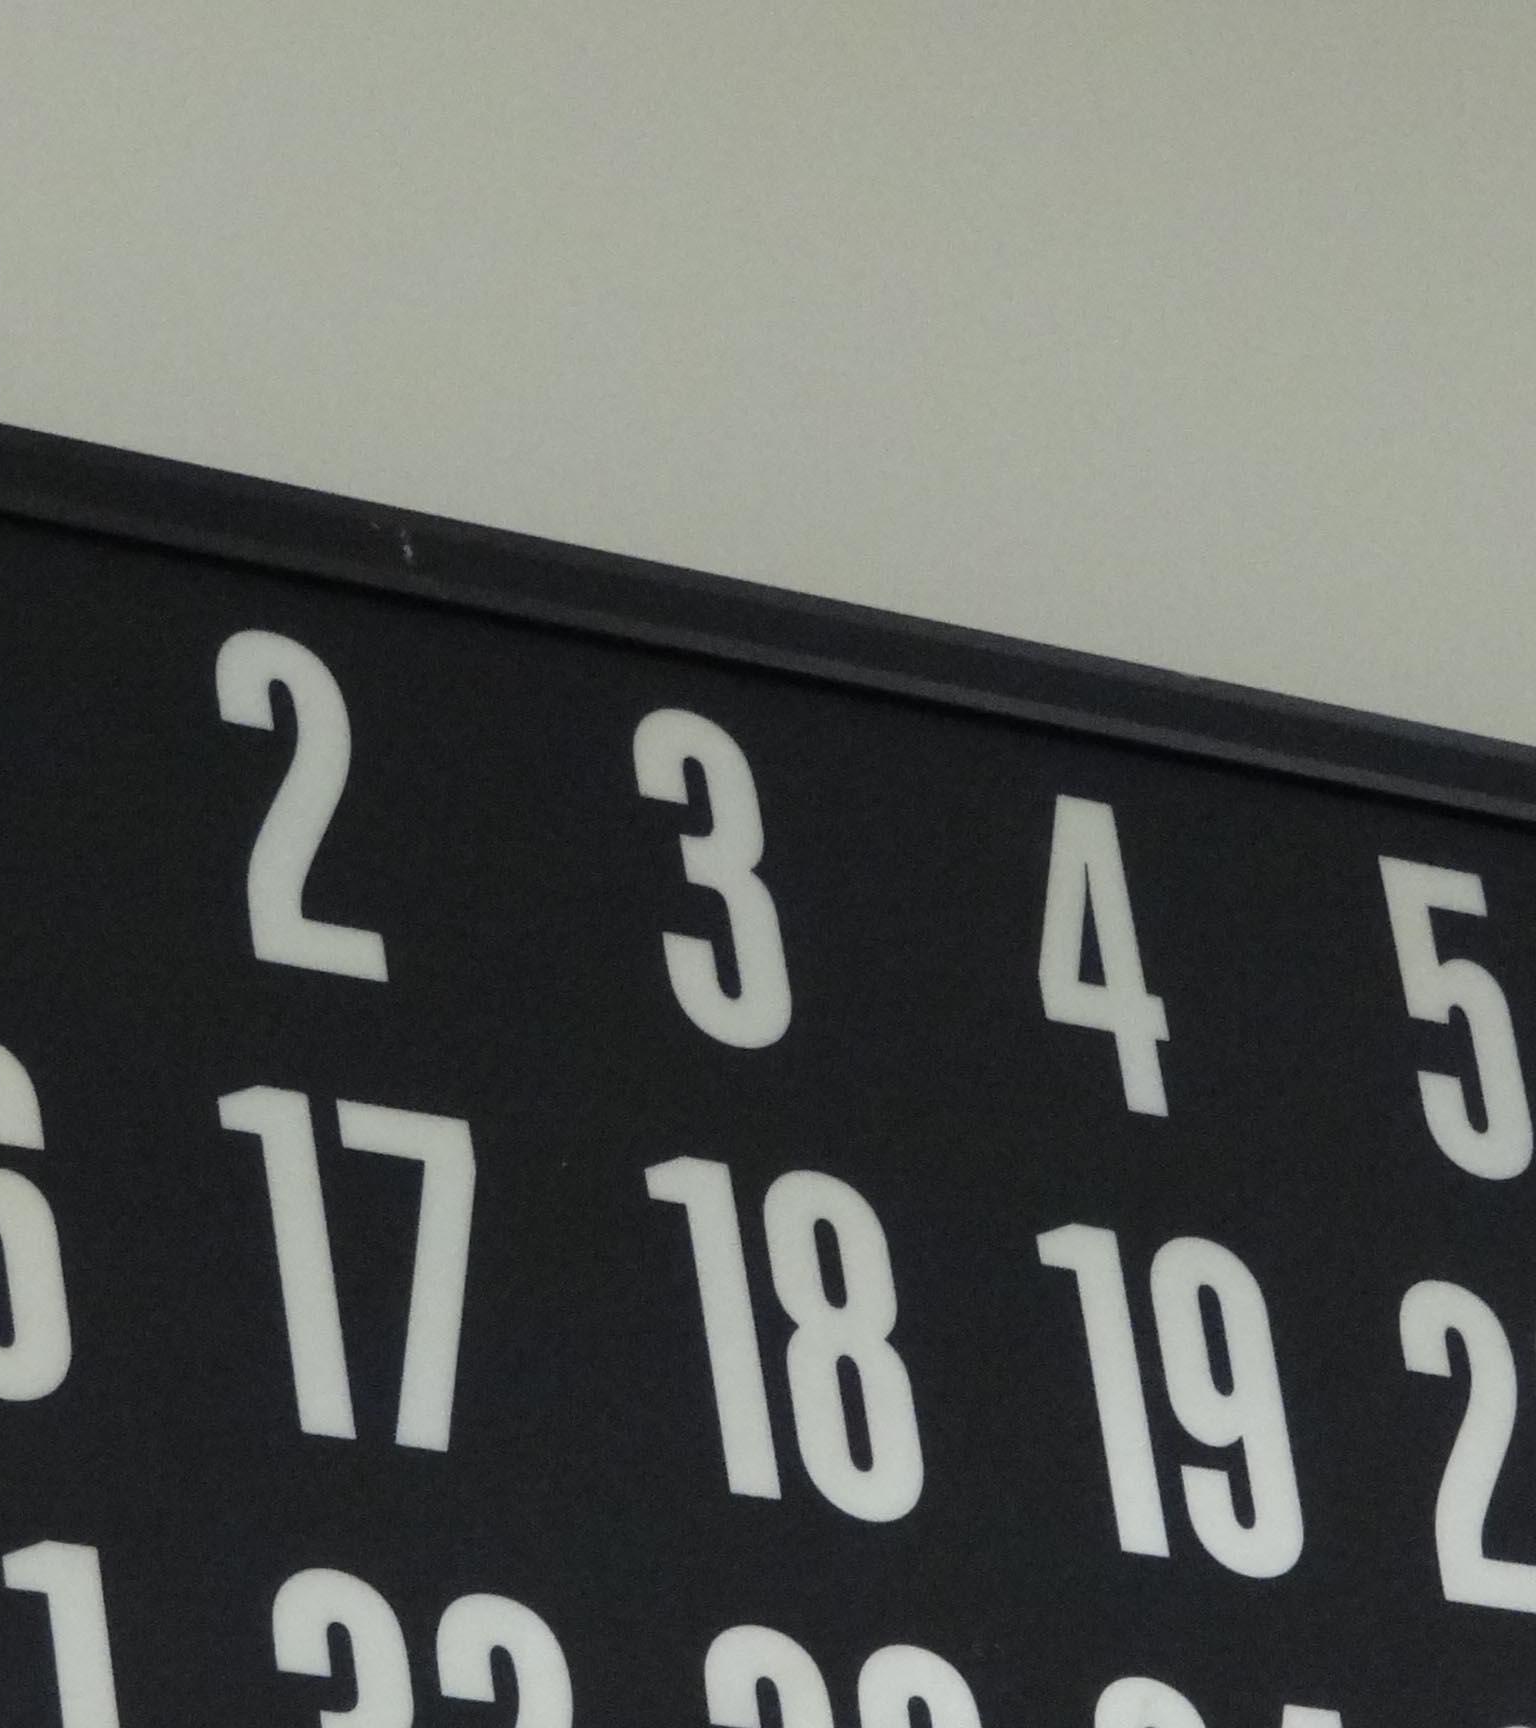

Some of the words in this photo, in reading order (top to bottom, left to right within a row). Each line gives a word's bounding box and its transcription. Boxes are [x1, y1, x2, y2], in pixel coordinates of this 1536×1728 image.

[216, 630, 388, 982] 2
[633, 709, 791, 1048] 3
[1039, 795, 1169, 1116] 4
[1379, 856, 1533, 1180] 5
[218, 1085, 476, 1452] 17
[645, 1156, 924, 1522] 18
[1037, 1223, 1304, 1578] 19
